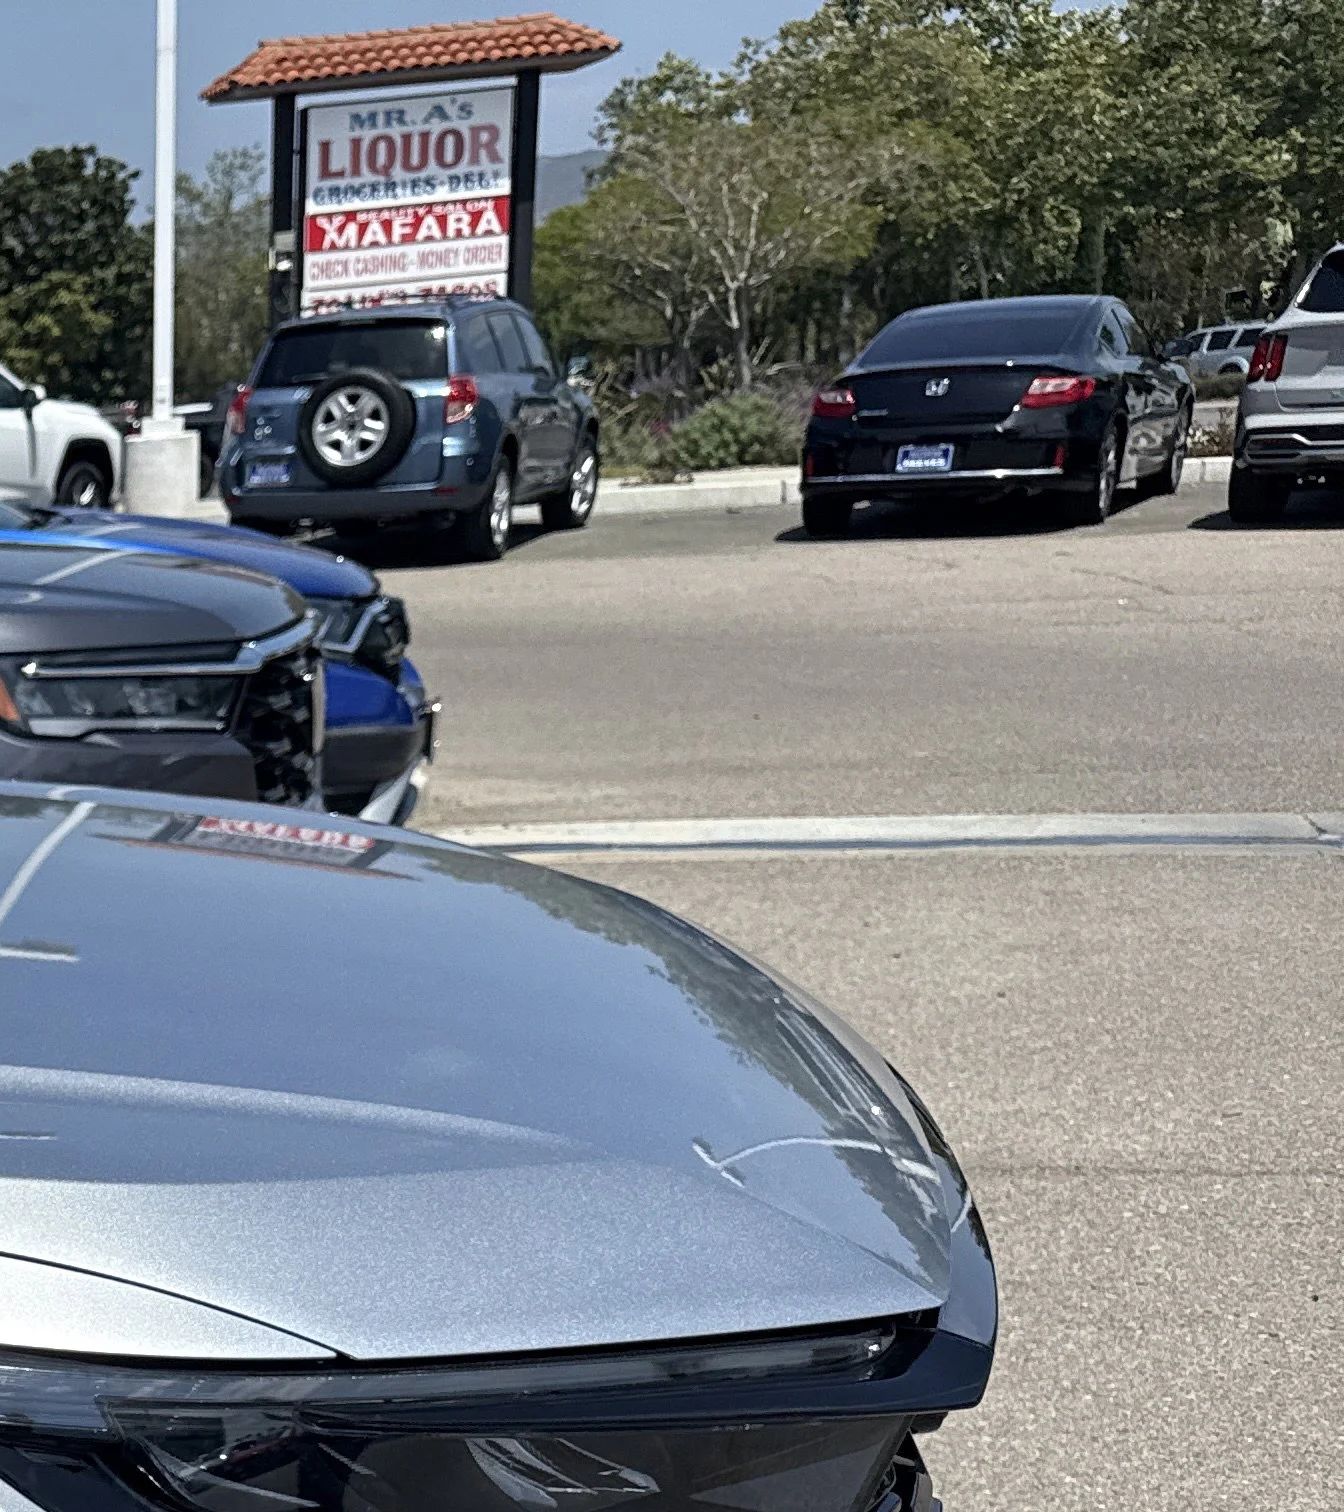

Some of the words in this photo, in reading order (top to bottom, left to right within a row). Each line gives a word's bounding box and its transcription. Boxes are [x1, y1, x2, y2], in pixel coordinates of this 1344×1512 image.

[349, 108, 417, 132] MR.
[318, 123, 504, 181] LIQUOR
[431, 199, 496, 217] SALON
[322, 208, 503, 250] MAFARA
